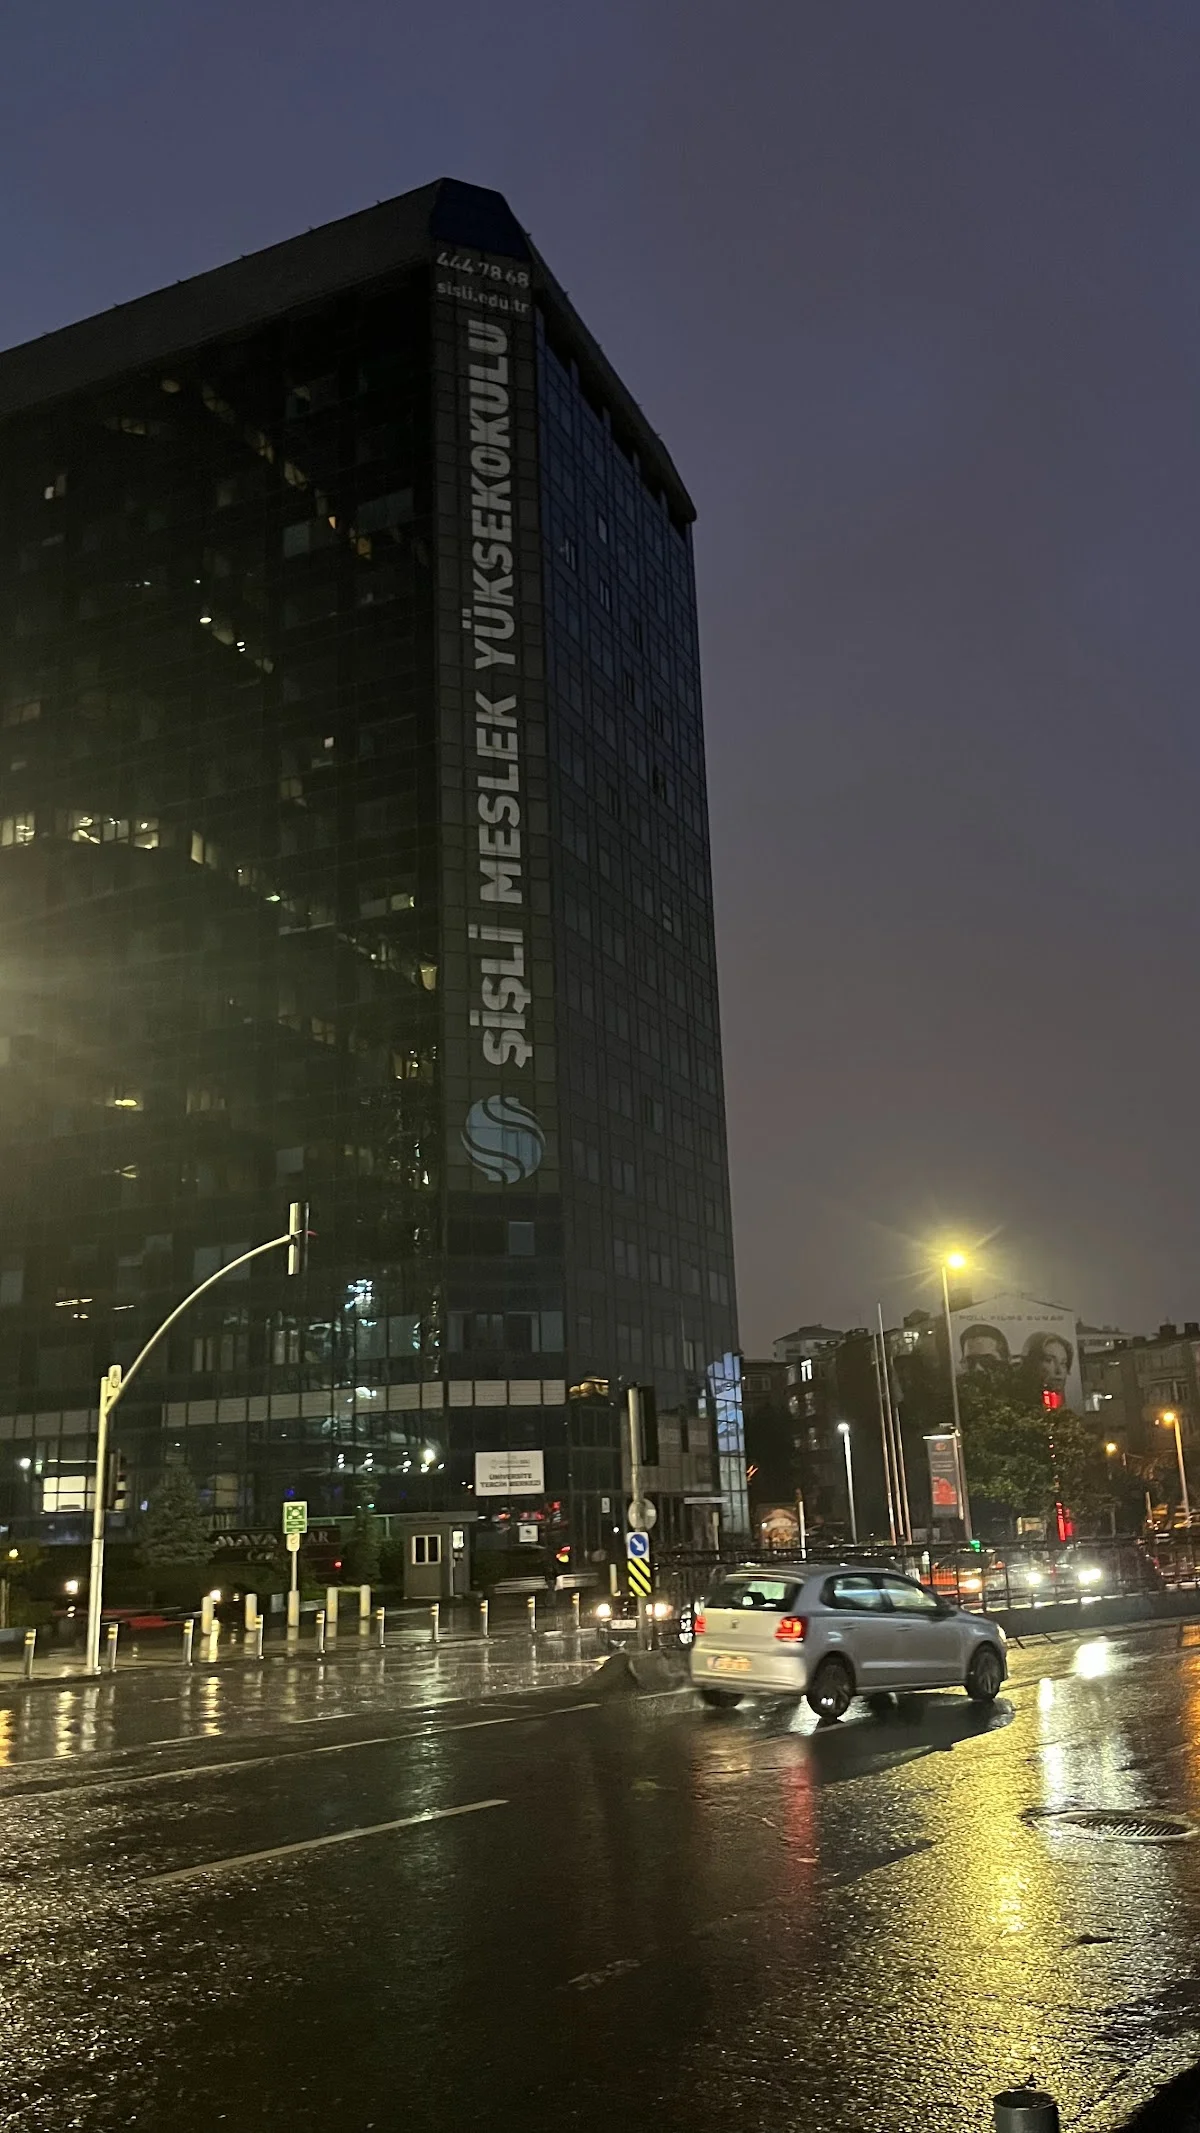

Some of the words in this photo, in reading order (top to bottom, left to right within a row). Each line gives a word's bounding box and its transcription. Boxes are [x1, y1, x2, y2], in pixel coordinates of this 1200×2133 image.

[437, 252, 474, 275] 444
[478, 262, 502, 280] 78
[506, 269, 529, 289] 68
[437, 281, 530, 313] sisli.edu.tr
[462, 318, 516, 671] YÜKSEKOKULU
[475, 689, 523, 905] MESLEK
